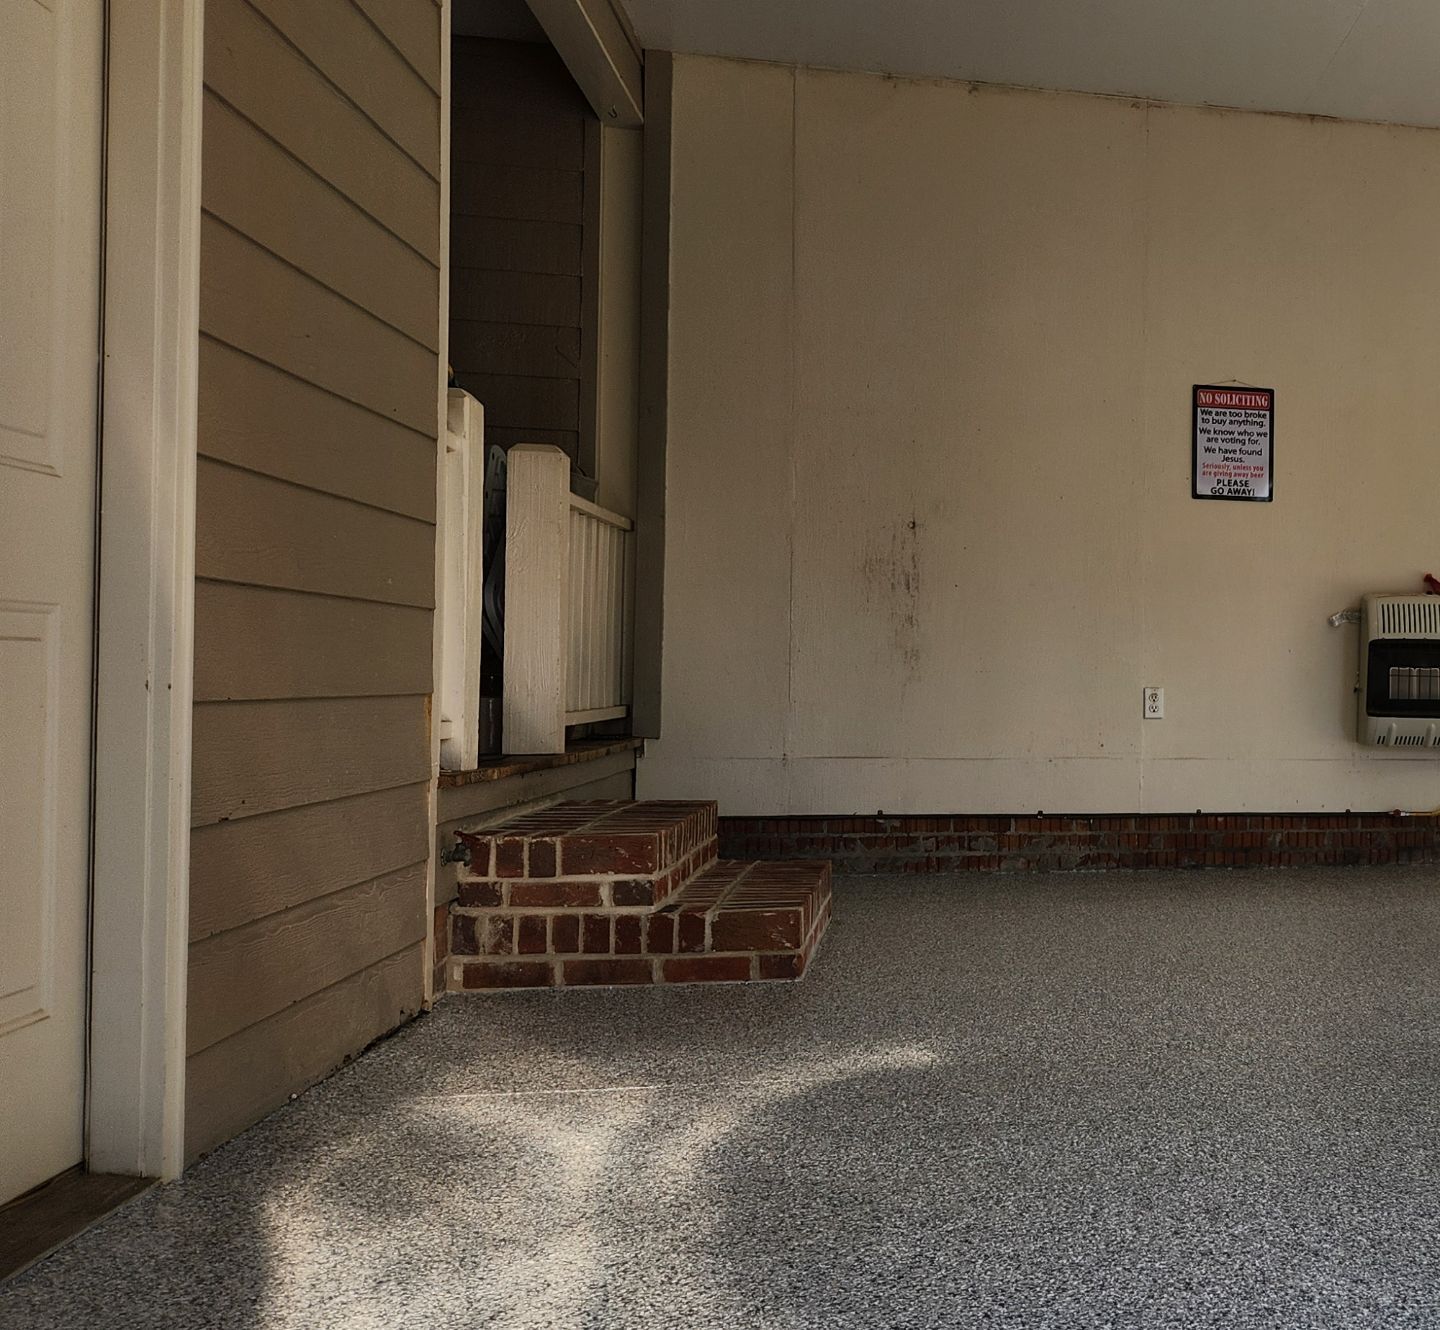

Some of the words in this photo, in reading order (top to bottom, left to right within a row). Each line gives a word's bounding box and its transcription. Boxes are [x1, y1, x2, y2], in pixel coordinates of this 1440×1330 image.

[1199, 392, 1213, 404] NO
[1215, 393, 1268, 407] SOLICITING
[1200, 409, 1213, 417] We
[1229, 410, 1243, 418] too
[1244, 411, 1267, 419] broke
[1212, 418, 1227, 427] buy
[1228, 418, 1266, 428] anything.
[1199, 427, 1211, 435] We
[1213, 427, 1235, 436] know
[1237, 429, 1255, 437] who
[1220, 436, 1246, 446] voting
[1248, 437, 1261, 445] for.
[1203, 446, 1217, 454] We
[1218, 446, 1238, 455] have
[1239, 447, 1263, 456] found
[1221, 455, 1245, 463] Jesus.
[1216, 478, 1250, 487] PLEASE
[1211, 486, 1224, 495] GO
[1227, 487, 1255, 496] AWAY!
